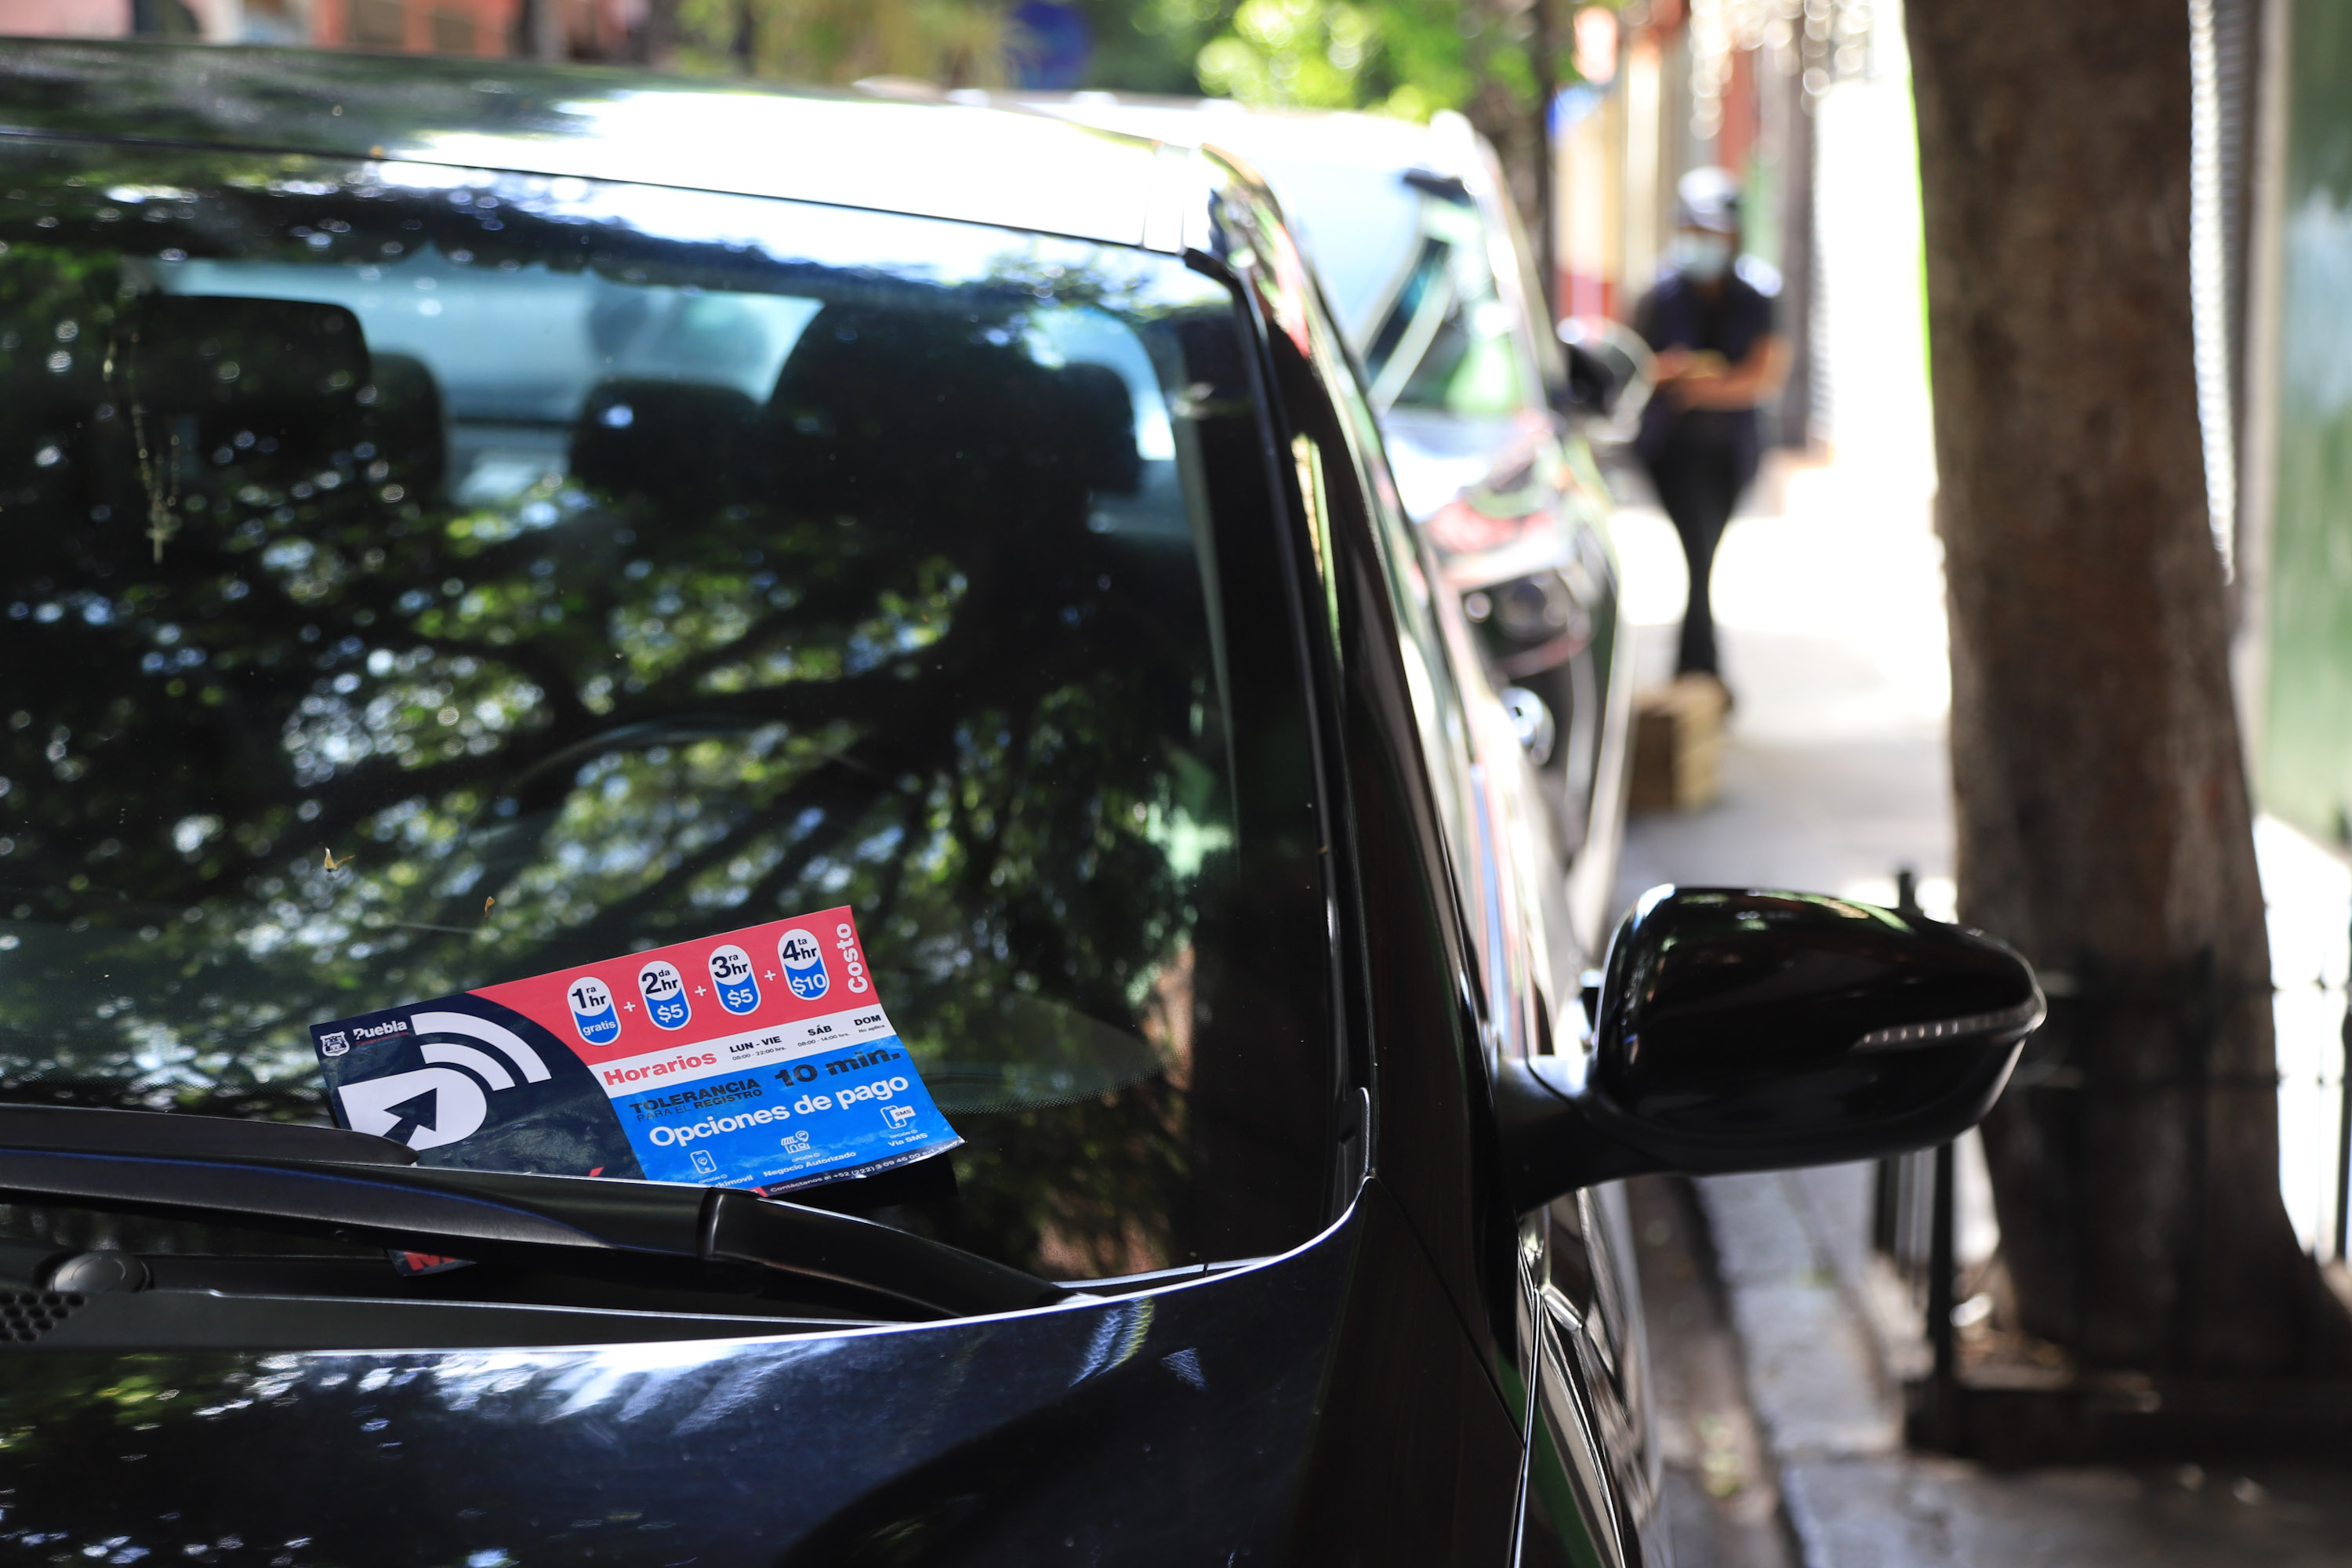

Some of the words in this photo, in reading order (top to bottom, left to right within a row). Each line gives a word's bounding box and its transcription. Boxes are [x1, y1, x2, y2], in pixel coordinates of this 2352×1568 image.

[800, 947, 818, 960] hr
[836, 923, 869, 994] Costo
[731, 964, 748, 975] hr
[661, 978, 678, 991] hr
[792, 974, 826, 995] $10
[589, 995, 606, 1007] hr
[727, 988, 753, 1008] $5
[657, 1004, 684, 1023] $5
[854, 1014, 882, 1026] DOM
[353, 1020, 408, 1040] Puebla
[583, 1020, 616, 1036] gratis
[808, 1025, 833, 1036] SÁB
[729, 1041, 754, 1053] LUN
[761, 1036, 782, 1047] VIE
[756, 1047, 775, 1056] 22:00
[603, 1053, 717, 1086] Horarios
[775, 1064, 818, 1087] 10
[825, 1049, 901, 1076] min.
[630, 1078, 761, 1113] TOLERANCIA
[637, 1107, 673, 1122] PARA
[675, 1104, 692, 1113] EL
[695, 1088, 763, 1109] REGISTRO
[649, 1105, 791, 1147] Opciones
[793, 1094, 833, 1115] de
[835, 1076, 909, 1110] pago
[895, 1109, 912, 1117] SMS
[905, 1132, 928, 1143] SMS
[763, 1163, 804, 1177] Negocio
[805, 1152, 857, 1167] Autorizado
[770, 1178, 823, 1192] Contáctanos
[851, 1166, 875, 1176] (222)
